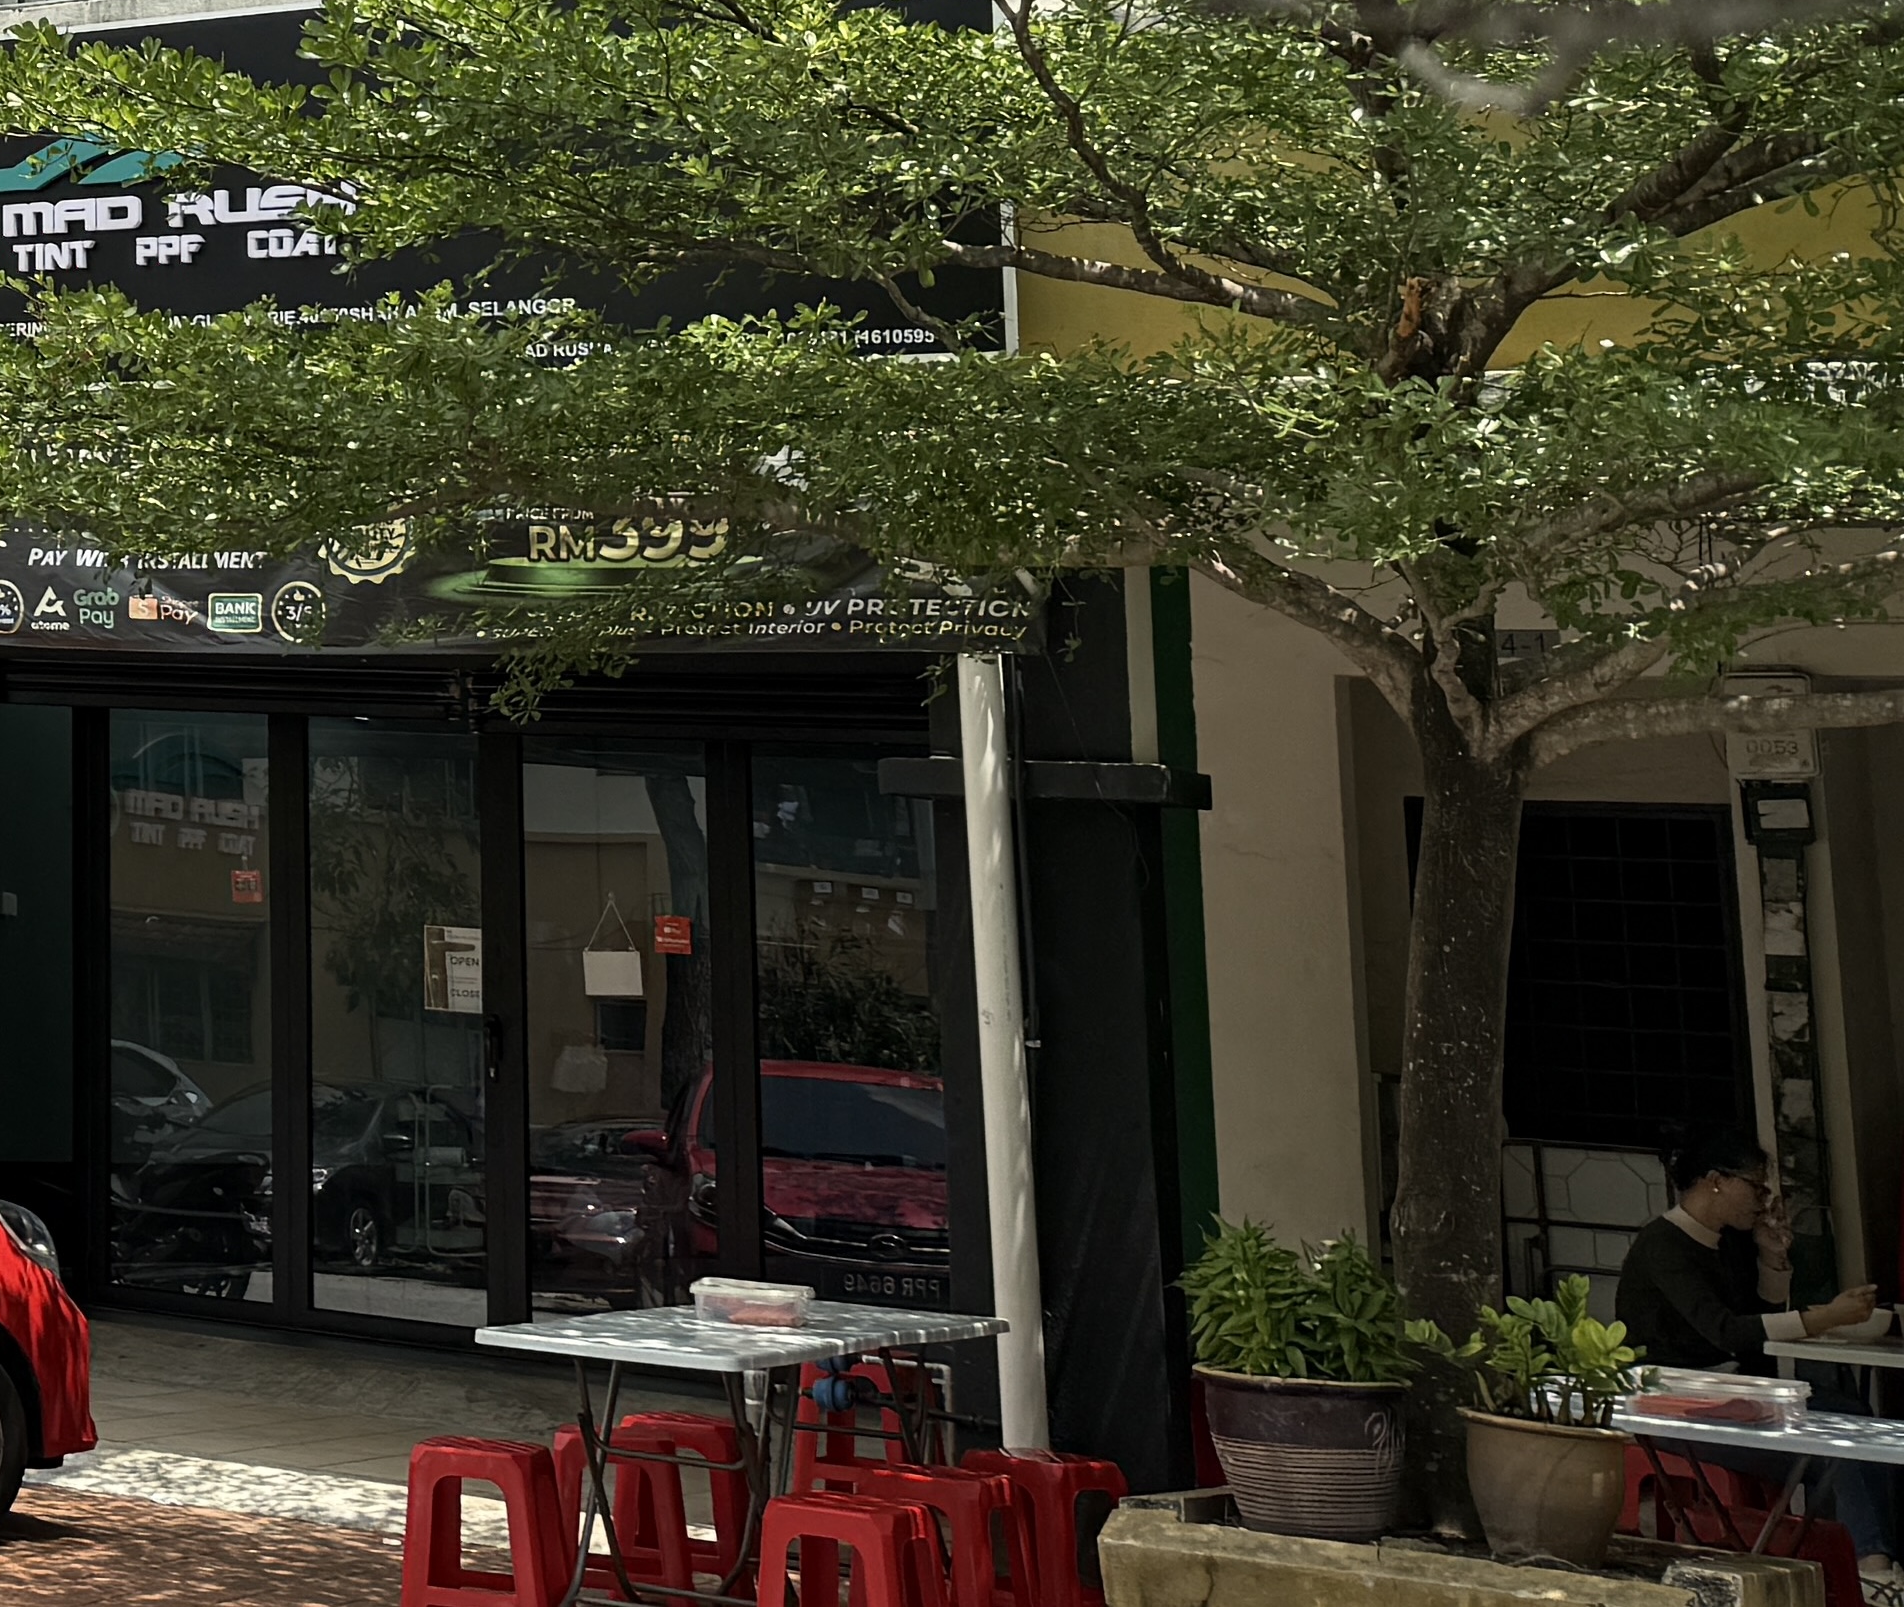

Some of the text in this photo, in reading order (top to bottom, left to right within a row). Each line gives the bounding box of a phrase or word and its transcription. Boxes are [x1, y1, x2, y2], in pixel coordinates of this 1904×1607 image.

[2, 195, 143, 237] MAD
[12, 240, 96, 272] TINT
[135, 234, 206, 266] PPF
[28, 548, 67, 566] PAY
[73, 587, 120, 606] Grab
[160, 604, 199, 625] Pay
[215, 602, 256, 615] BANK
[79, 608, 114, 629] Pay
[749, 620, 825, 635] Interior
[451, 956, 479, 967] OPEN
